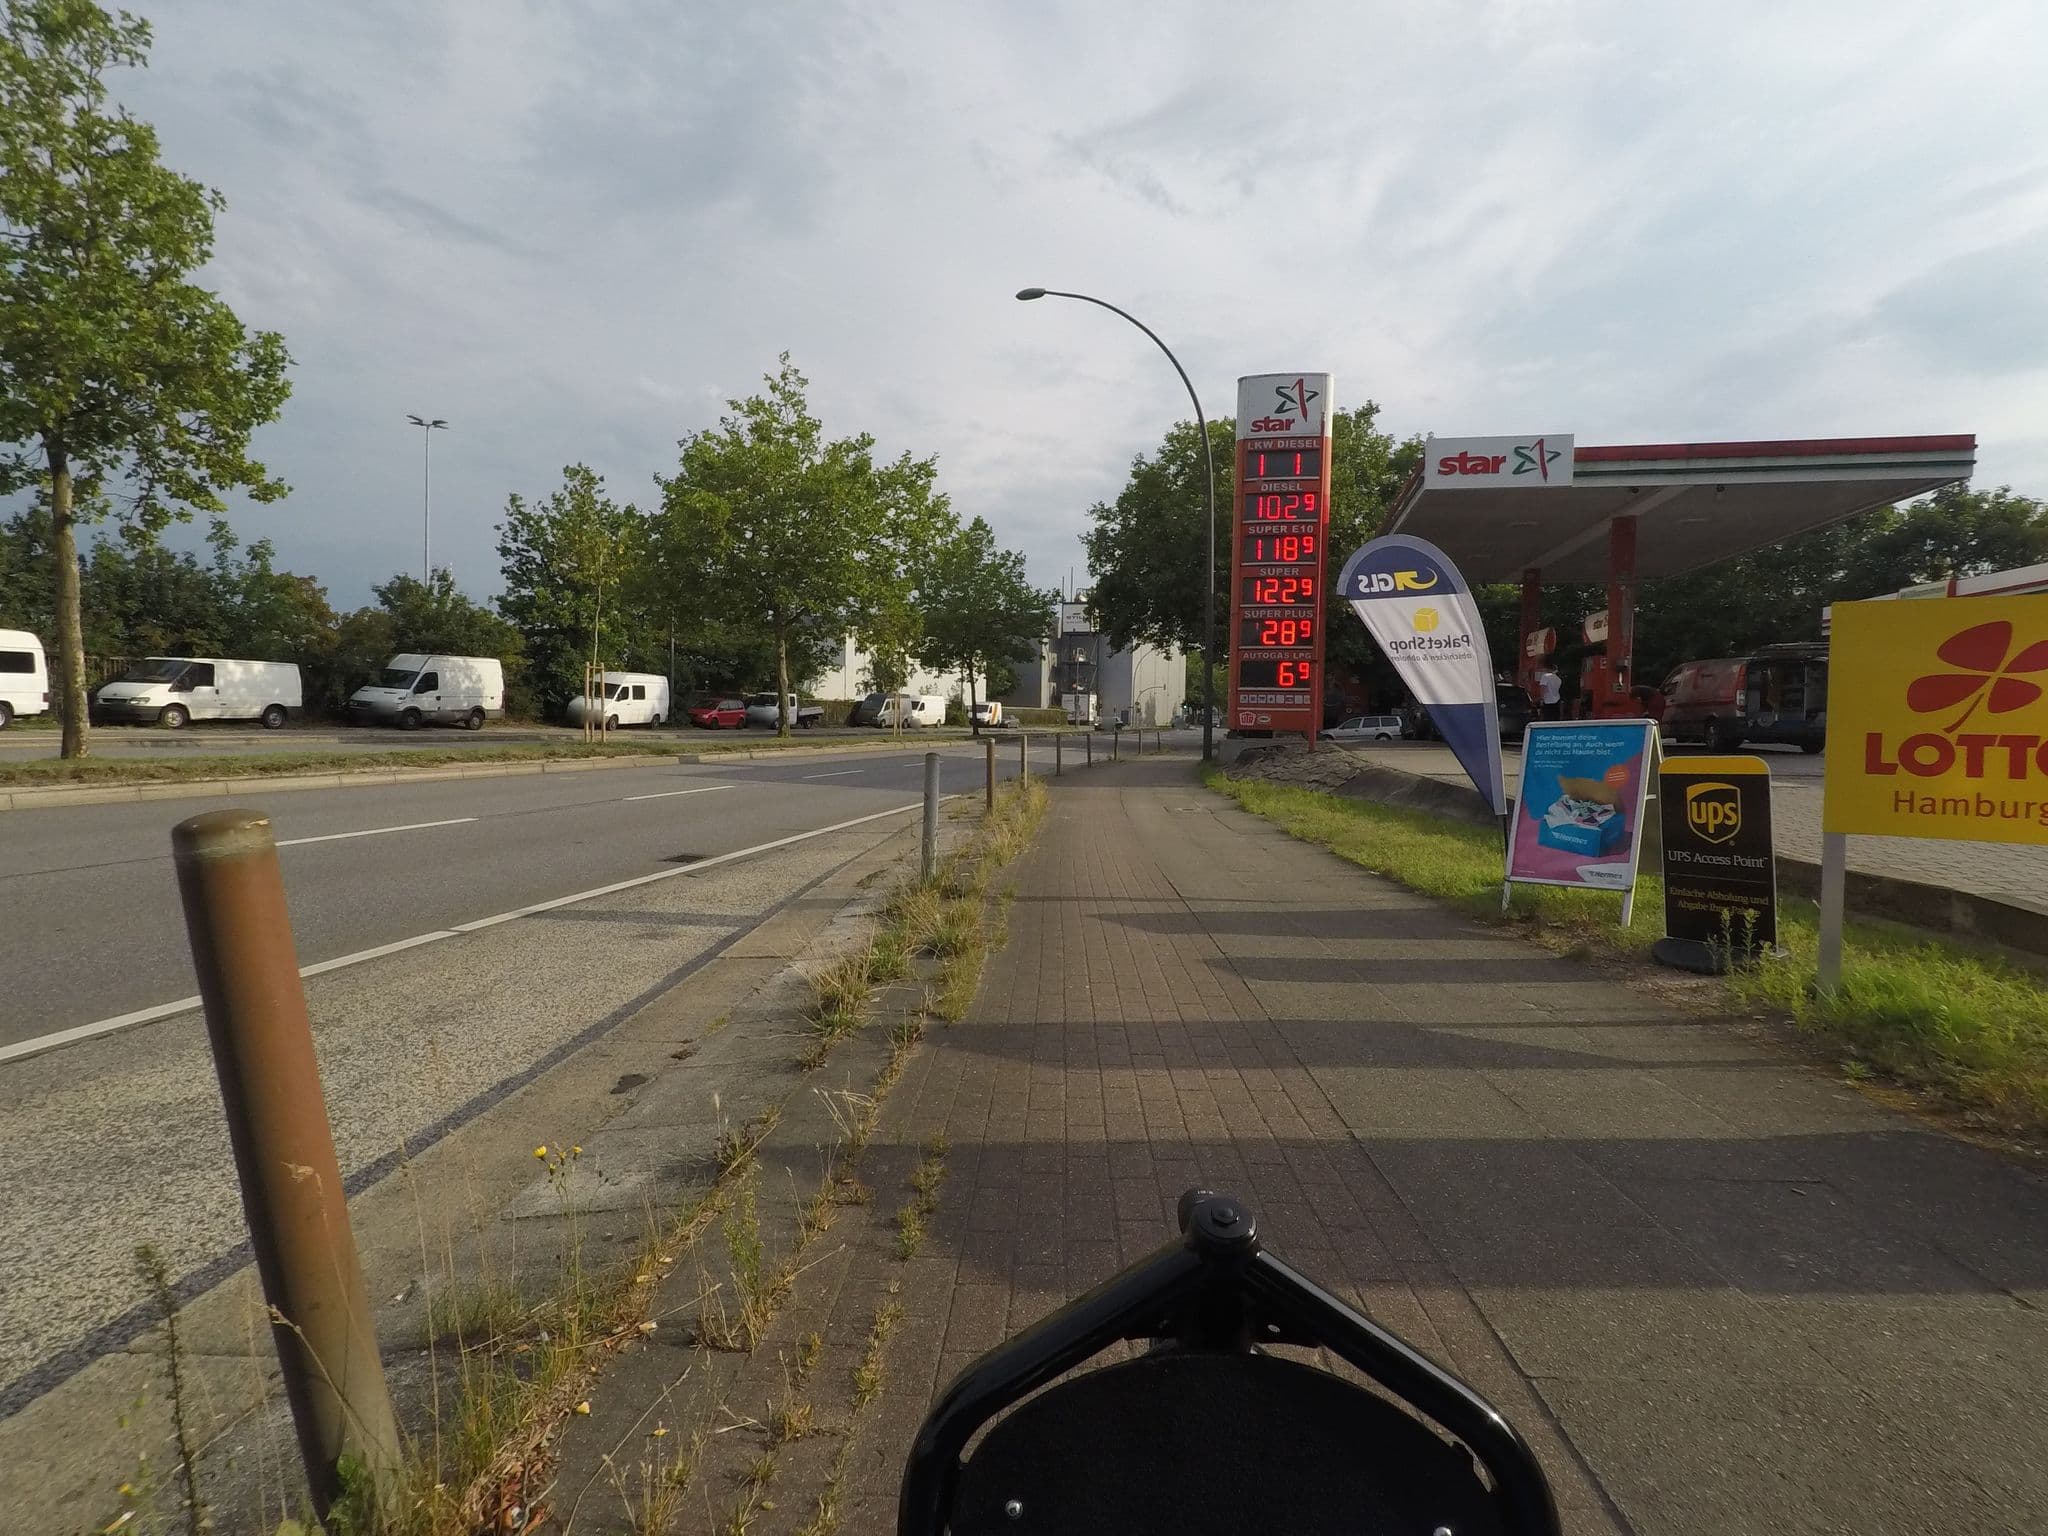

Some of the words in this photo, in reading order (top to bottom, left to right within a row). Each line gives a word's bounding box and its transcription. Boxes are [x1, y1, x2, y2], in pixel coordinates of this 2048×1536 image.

[1250, 415, 1296, 433] star
[1247, 441, 1273, 450] LKW
[1277, 439, 1320, 449] DIESEL
[1437, 450, 1507, 476] star
[1260, 482, 1303, 492] DIESEL
[1257, 493, 1315, 520] 1029
[1248, 525, 1288, 534] SUPER
[1292, 525, 1314, 533] E10
[1256, 535, 1314, 561] 1189
[1260, 567, 1299, 576] SUPER
[1254, 578, 1313, 604] 1229
[1244, 610, 1281, 618] SUPER
[1284, 609, 1313, 618] PLUS
[1243, 652, 1290, 660] AUTOGAS
[1293, 652, 1312, 660] LPG
[1865, 732, 2048, 780] LOTT
[1691, 801, 1738, 834] ups
[1667, 849, 1691, 863] UPS
[1693, 852, 1731, 866] Access
